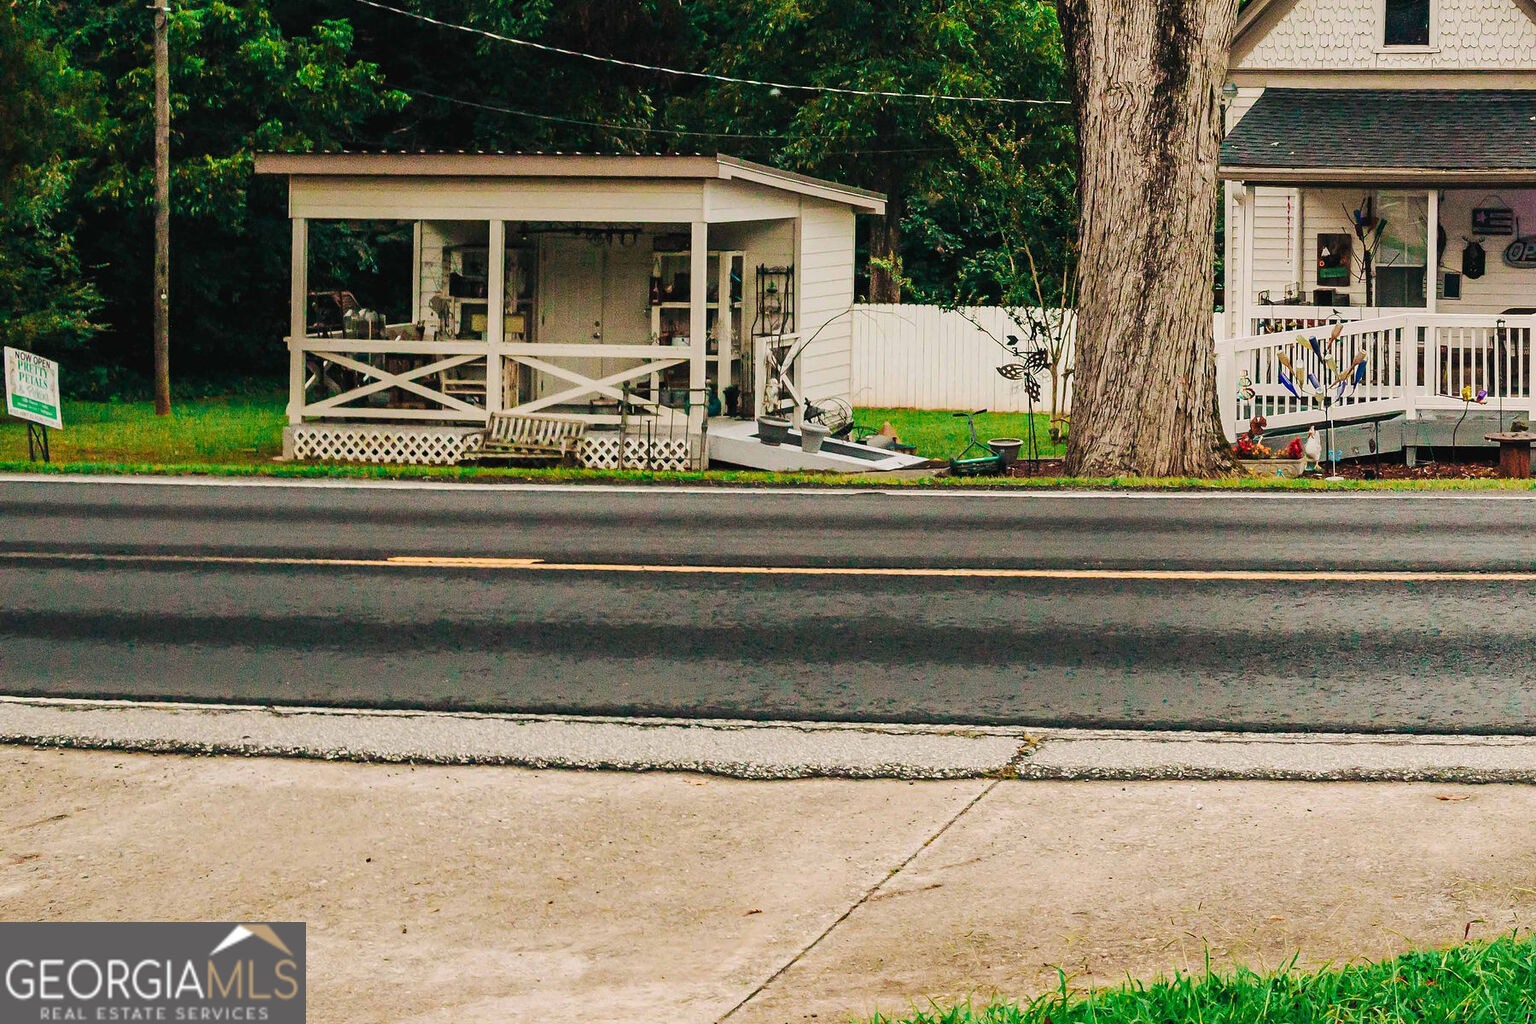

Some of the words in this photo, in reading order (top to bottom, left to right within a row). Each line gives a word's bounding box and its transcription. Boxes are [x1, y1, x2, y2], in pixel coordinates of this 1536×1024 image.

[14, 351, 32, 363] NOW
[33, 356, 51, 369] OPEN
[17, 360, 48, 379] PRETTY
[19, 372, 48, 389] PETALS
